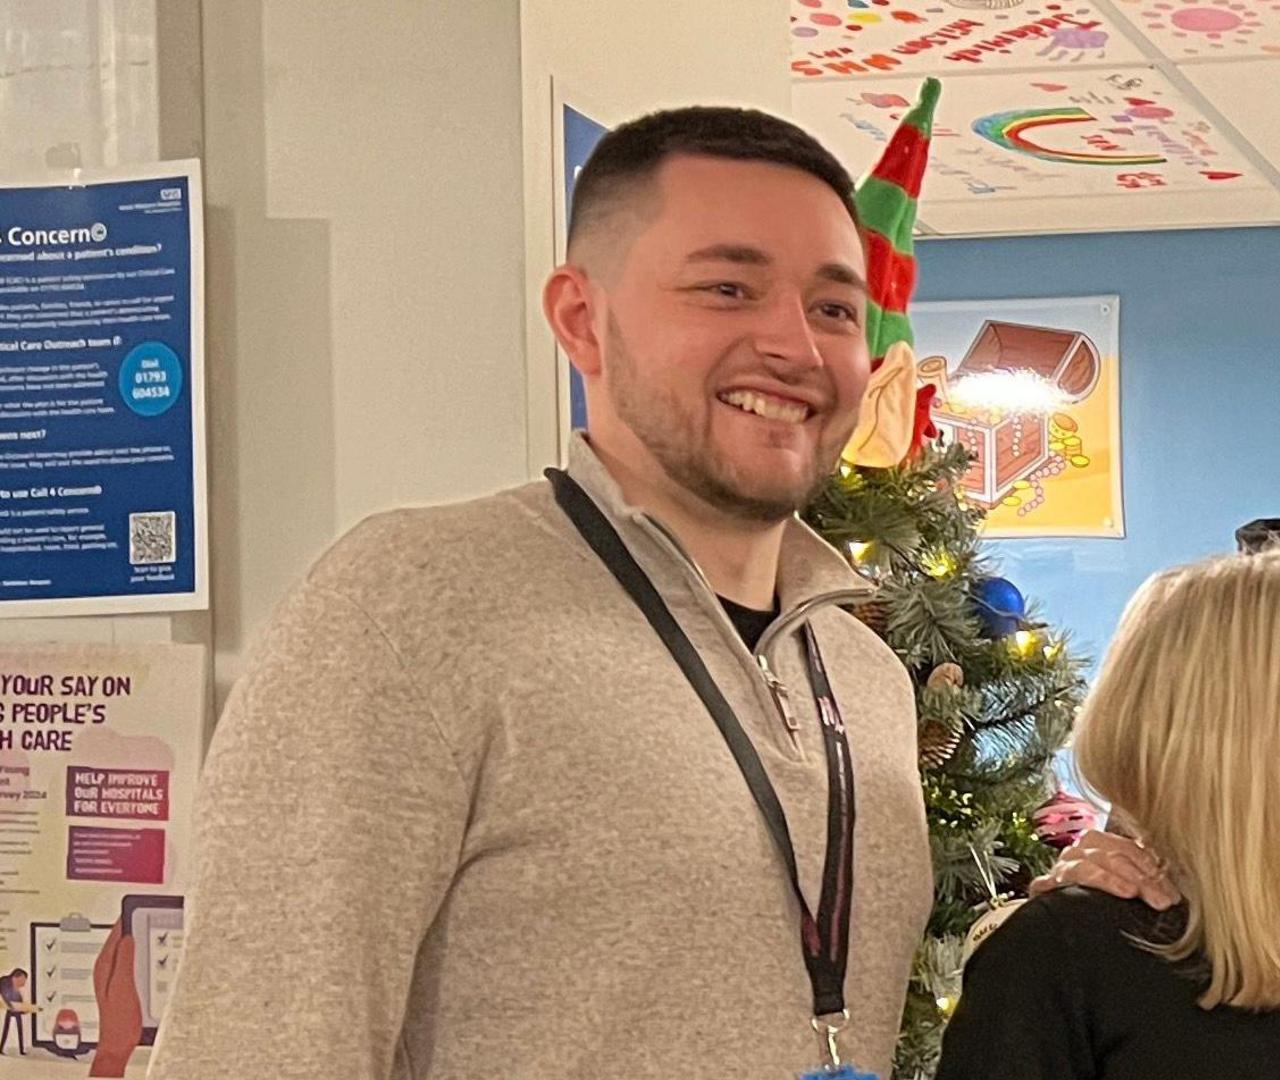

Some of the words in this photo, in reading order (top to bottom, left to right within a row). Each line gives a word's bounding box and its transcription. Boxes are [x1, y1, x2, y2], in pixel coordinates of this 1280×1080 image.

[1, 674, 53, 696] YOUR
[60, 675, 99, 697] SAY
[102, 676, 131, 697] ON
[12, 703, 106, 724] PEOPLE'S
[21, 730, 73, 751] CARE
[74, 772, 105, 786] HELP
[107, 773, 158, 787] IMPROVE
[74, 786, 99, 799] OUR
[101, 787, 163, 801] HOSPITALS
[73, 800, 99, 814] FOR
[100, 801, 160, 815] EVERYONE
